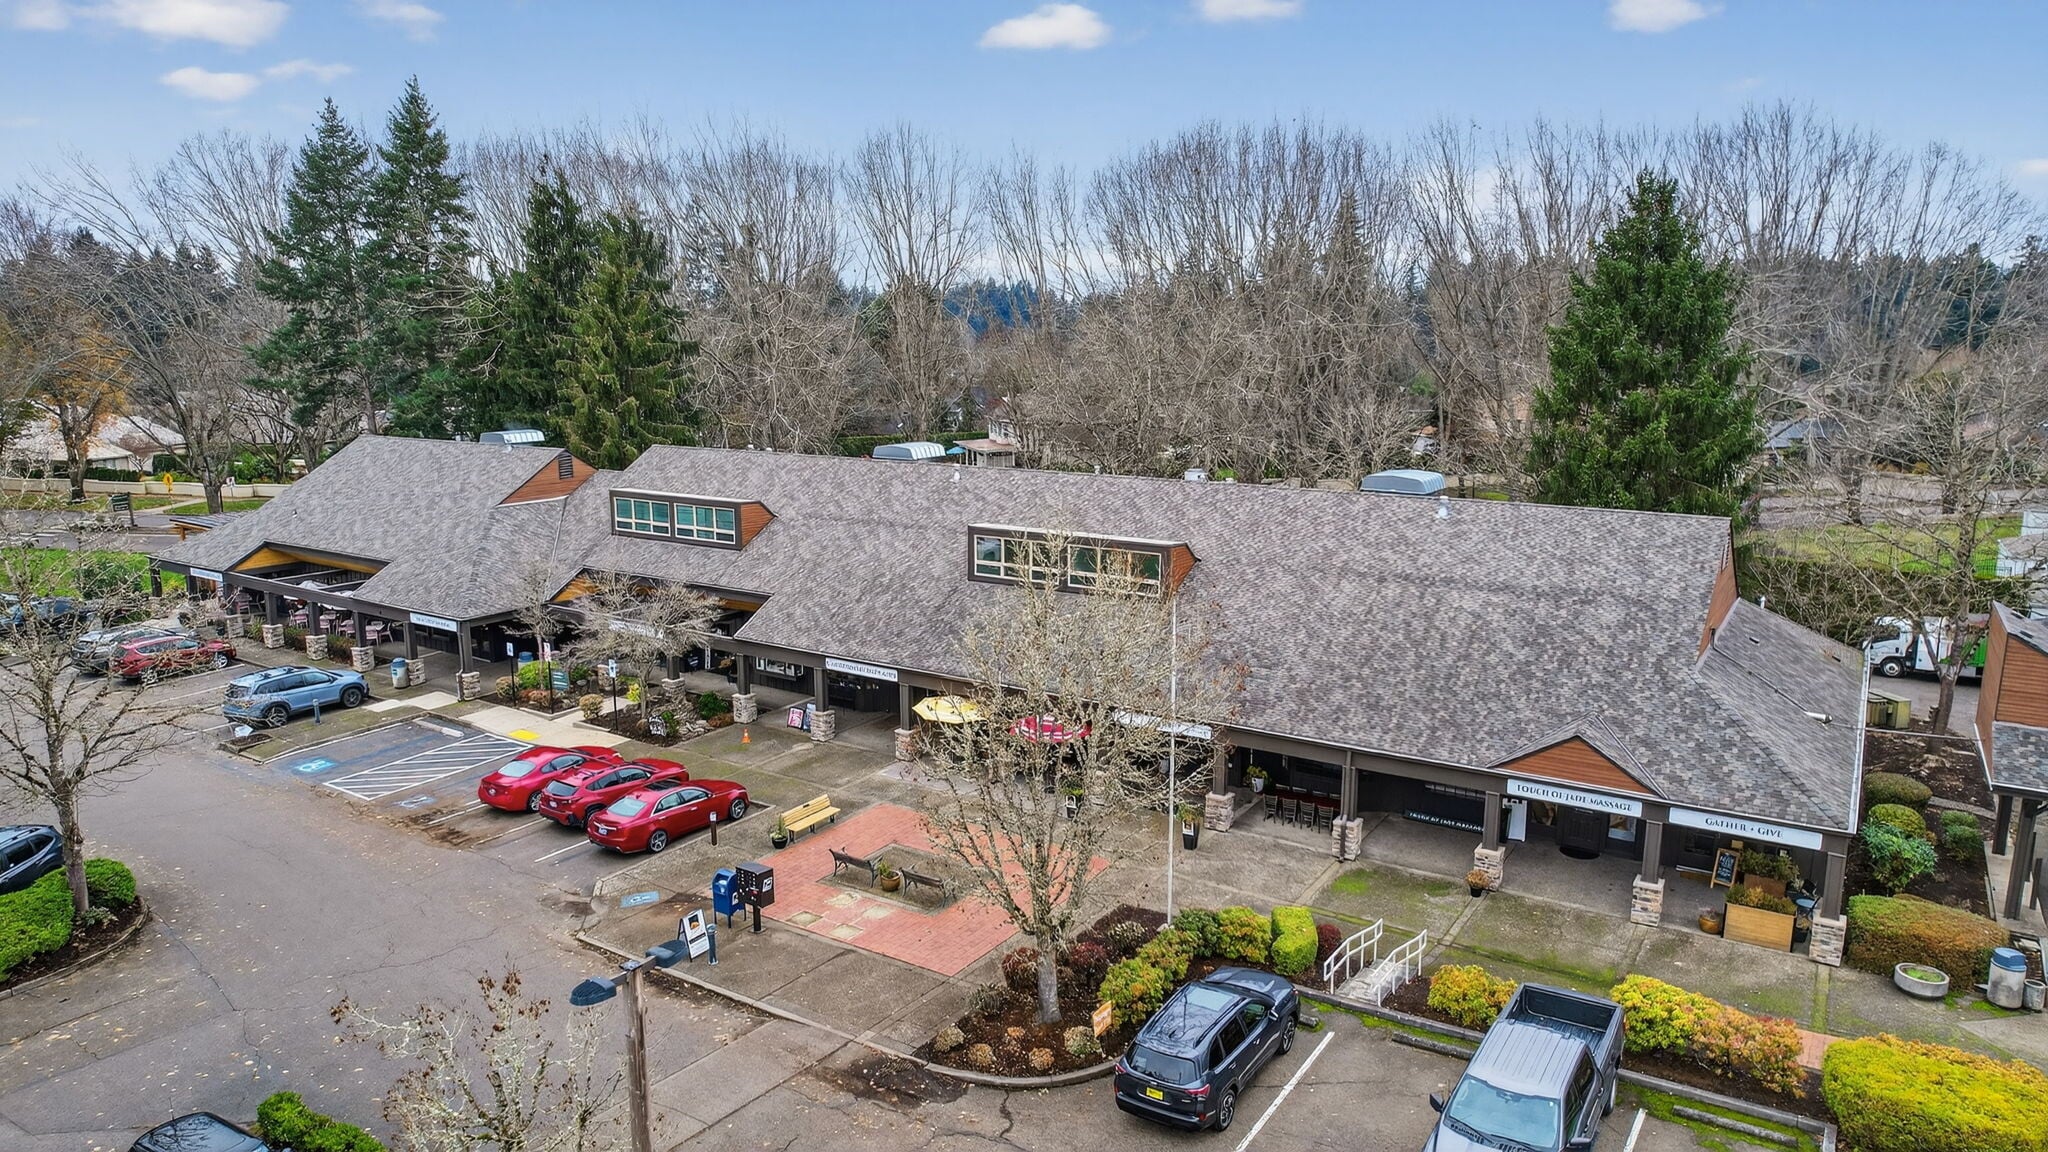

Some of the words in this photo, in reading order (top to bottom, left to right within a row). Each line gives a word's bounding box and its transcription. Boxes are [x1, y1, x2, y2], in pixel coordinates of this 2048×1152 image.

[1517, 784, 1549, 796] TOUCH
[1551, 790, 1562, 799] OF
[1589, 798, 1633, 812] MASSAGE
[1705, 817, 1746, 832] GATHER
[1757, 827, 1783, 838] GIVE
